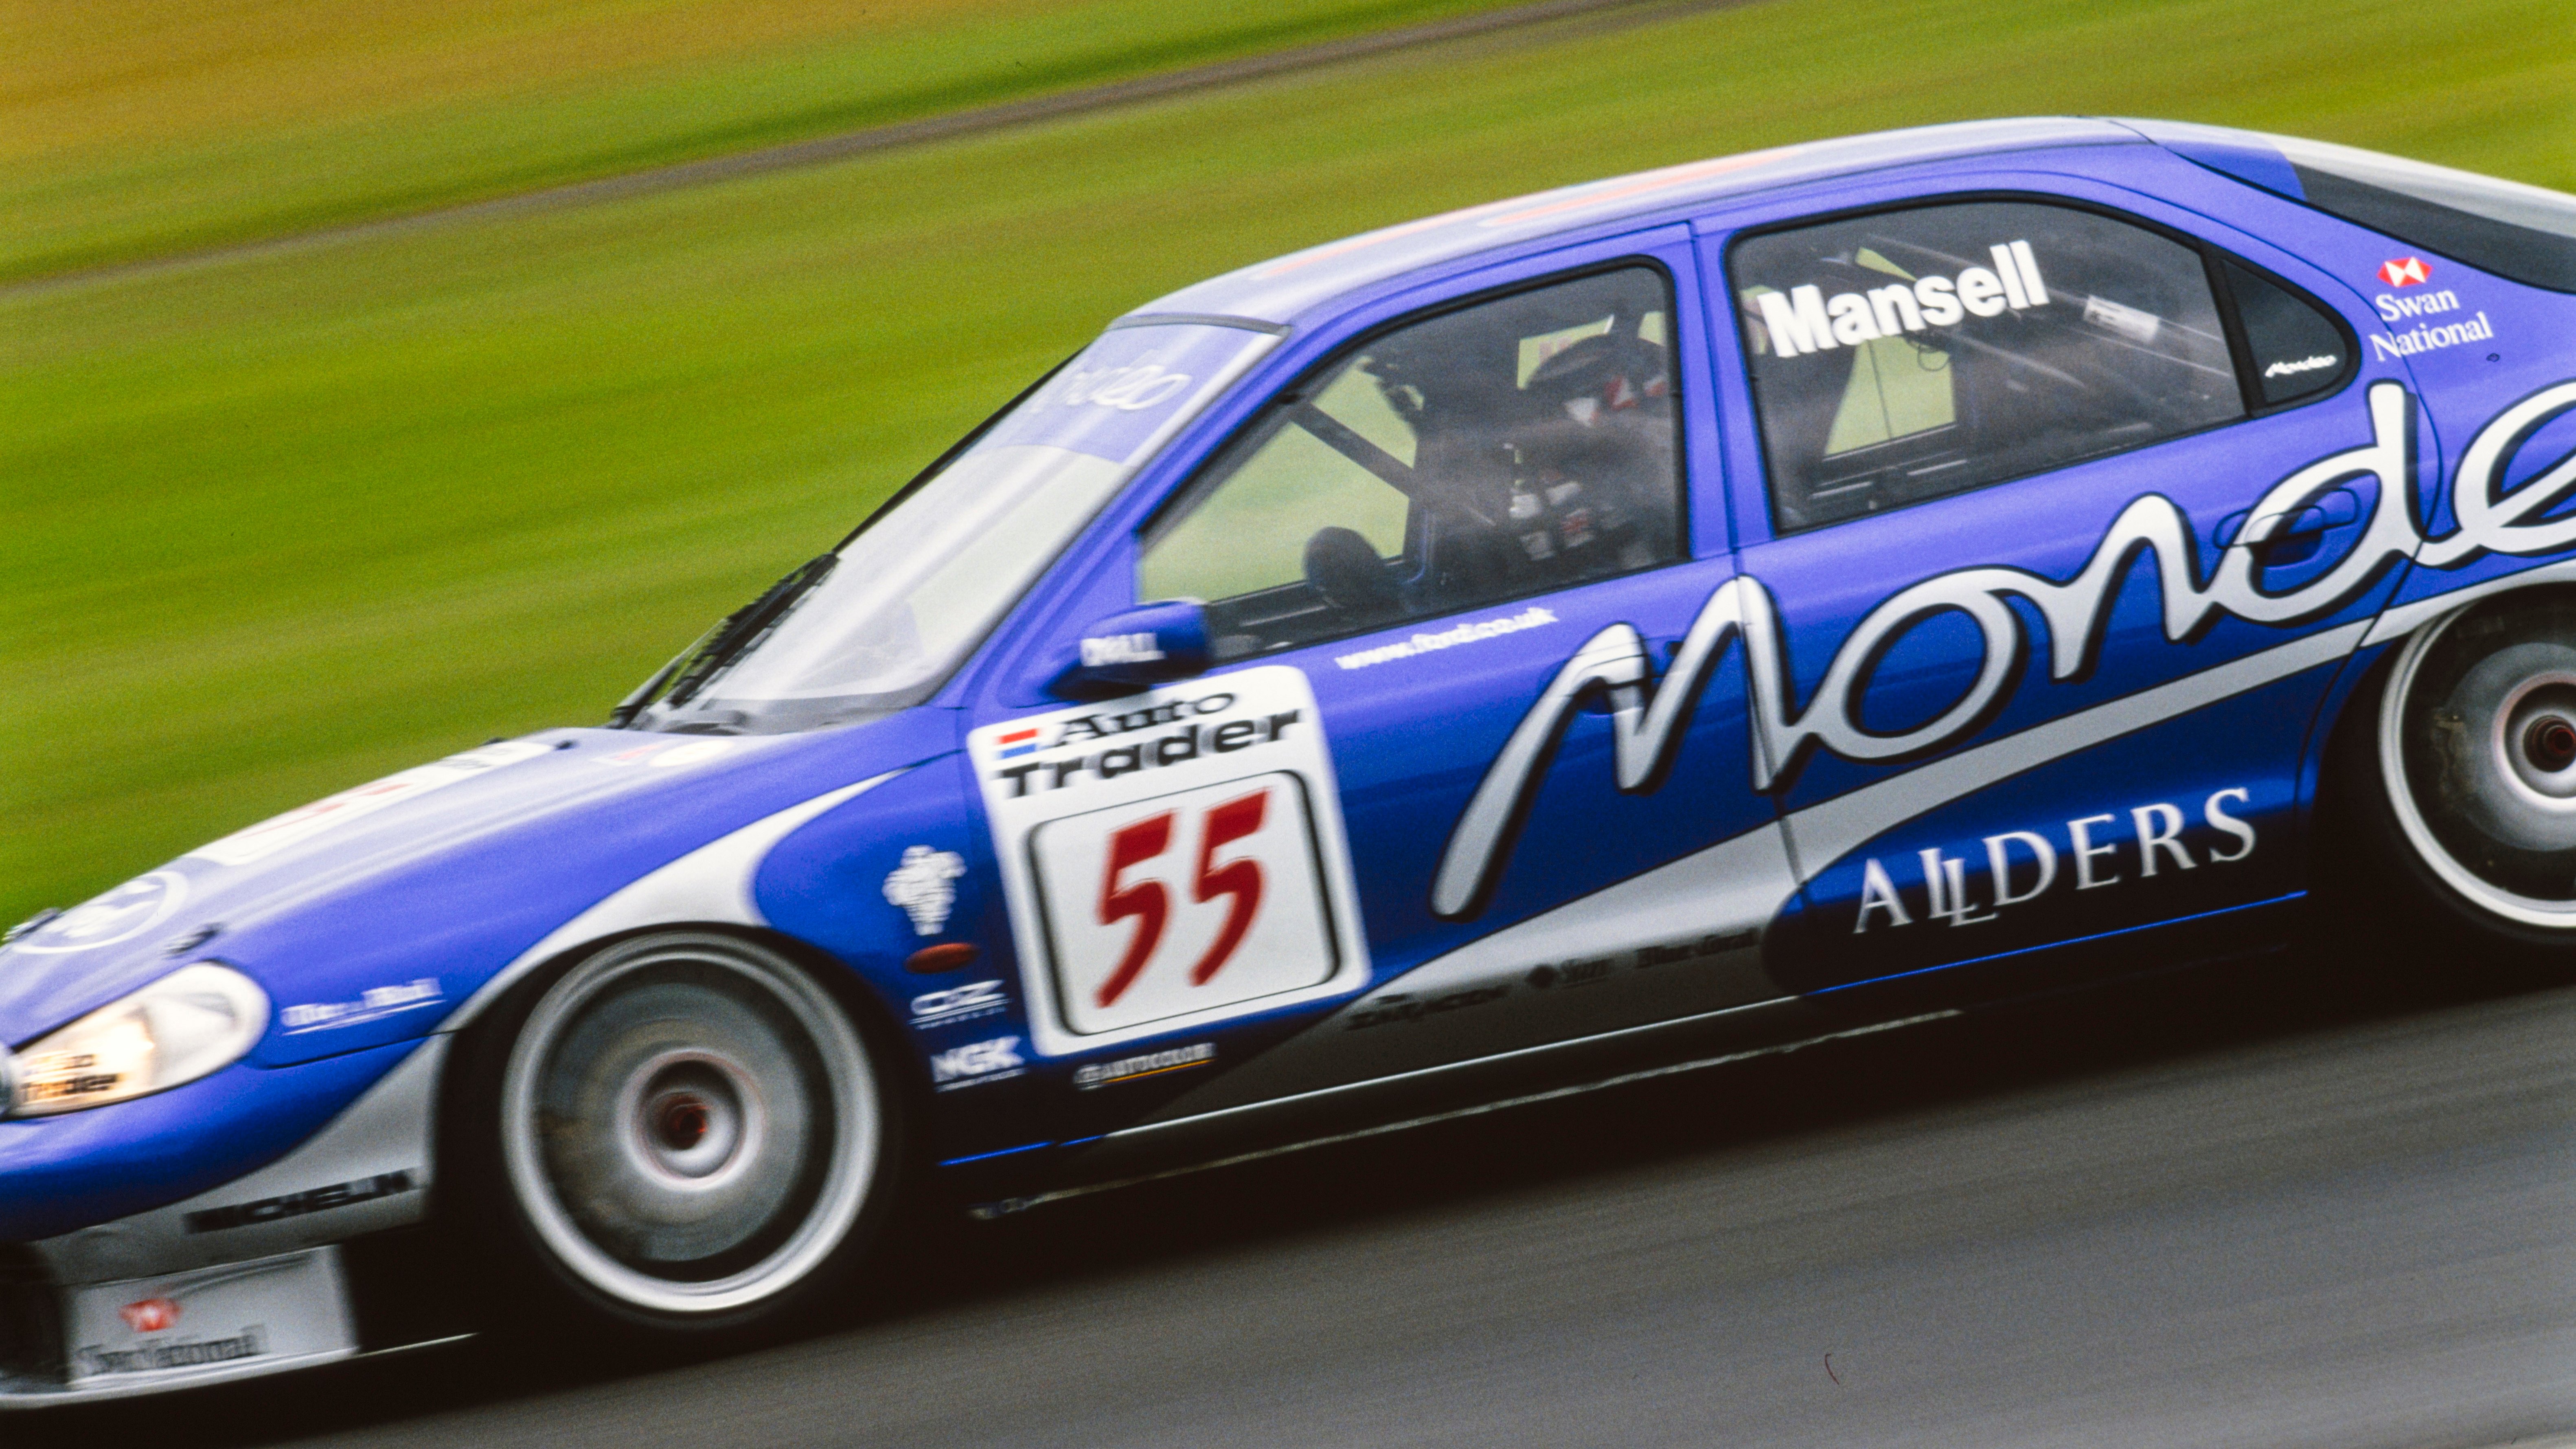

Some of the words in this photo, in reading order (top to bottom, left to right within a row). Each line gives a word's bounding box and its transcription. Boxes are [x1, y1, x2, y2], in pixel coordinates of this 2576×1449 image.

[1756, 239, 2050, 358] Mansell
[2376, 289, 2460, 322] Swan
[2370, 311, 2494, 362] National
[989, 707, 1303, 799] Trader
[1053, 692, 1235, 747] Auto
[1091, 785, 1274, 1009] 55
[1853, 787, 2256, 934] ALLDERS
[931, 1035, 1025, 1085] NGK
